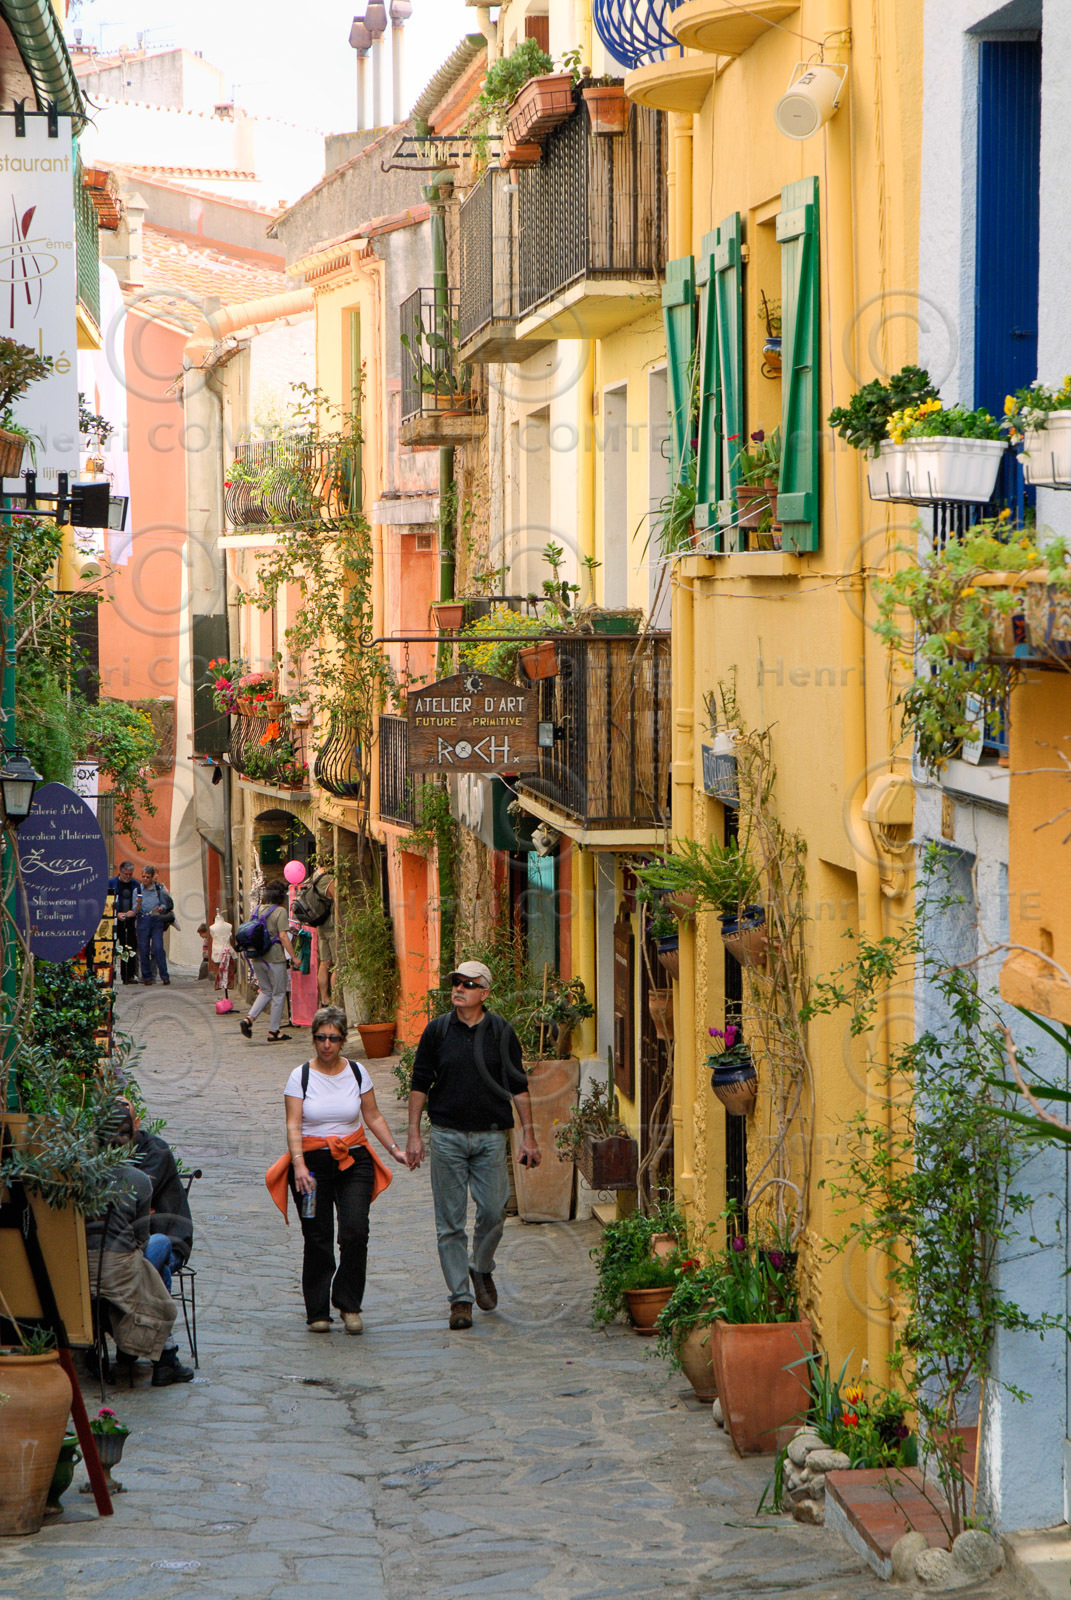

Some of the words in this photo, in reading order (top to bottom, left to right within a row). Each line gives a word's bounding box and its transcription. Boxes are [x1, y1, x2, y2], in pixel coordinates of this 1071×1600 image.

[415, 697, 472, 713] ATELIER
[484, 696, 525, 713] D'ART
[416, 717, 457, 726] FUTURE
[472, 717, 523, 726] PRIMITIVE
[60, 803, 84, 815] d'Art
[49, 819, 57, 829] &
[17, 831, 56, 841] écoration
[59, 829, 102, 840] d'Intérieur
[20, 848, 94, 876] Zaza
[32, 895, 77, 907] Showroom
[36, 909, 74, 922] Boutique
